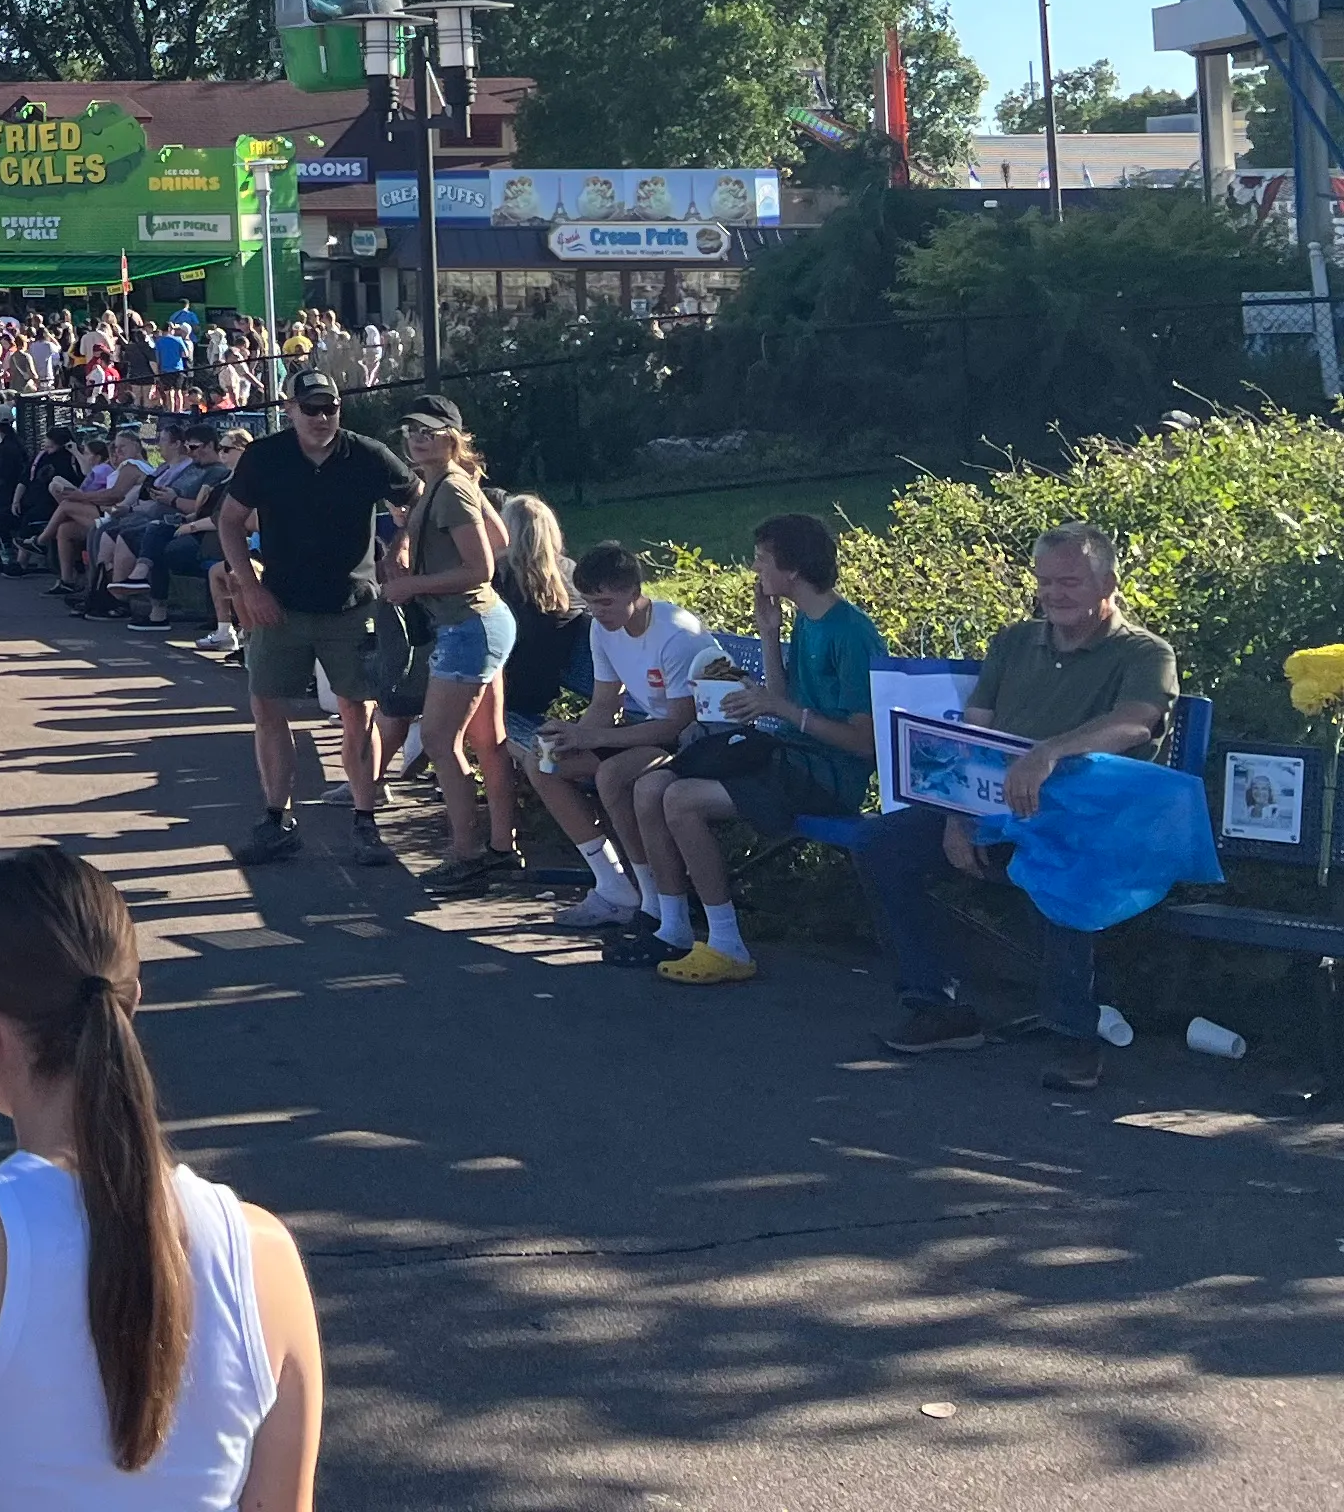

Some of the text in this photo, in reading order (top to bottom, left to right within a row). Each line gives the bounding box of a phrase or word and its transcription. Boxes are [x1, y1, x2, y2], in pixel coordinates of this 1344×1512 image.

[148, 176, 221, 191] DRINKS
[380, 184, 485, 208] CREA PUFFS
[1, 215, 61, 229] PERFECT
[183, 220, 219, 233] PICKLE
[589, 227, 689, 246] Cream Puffs
